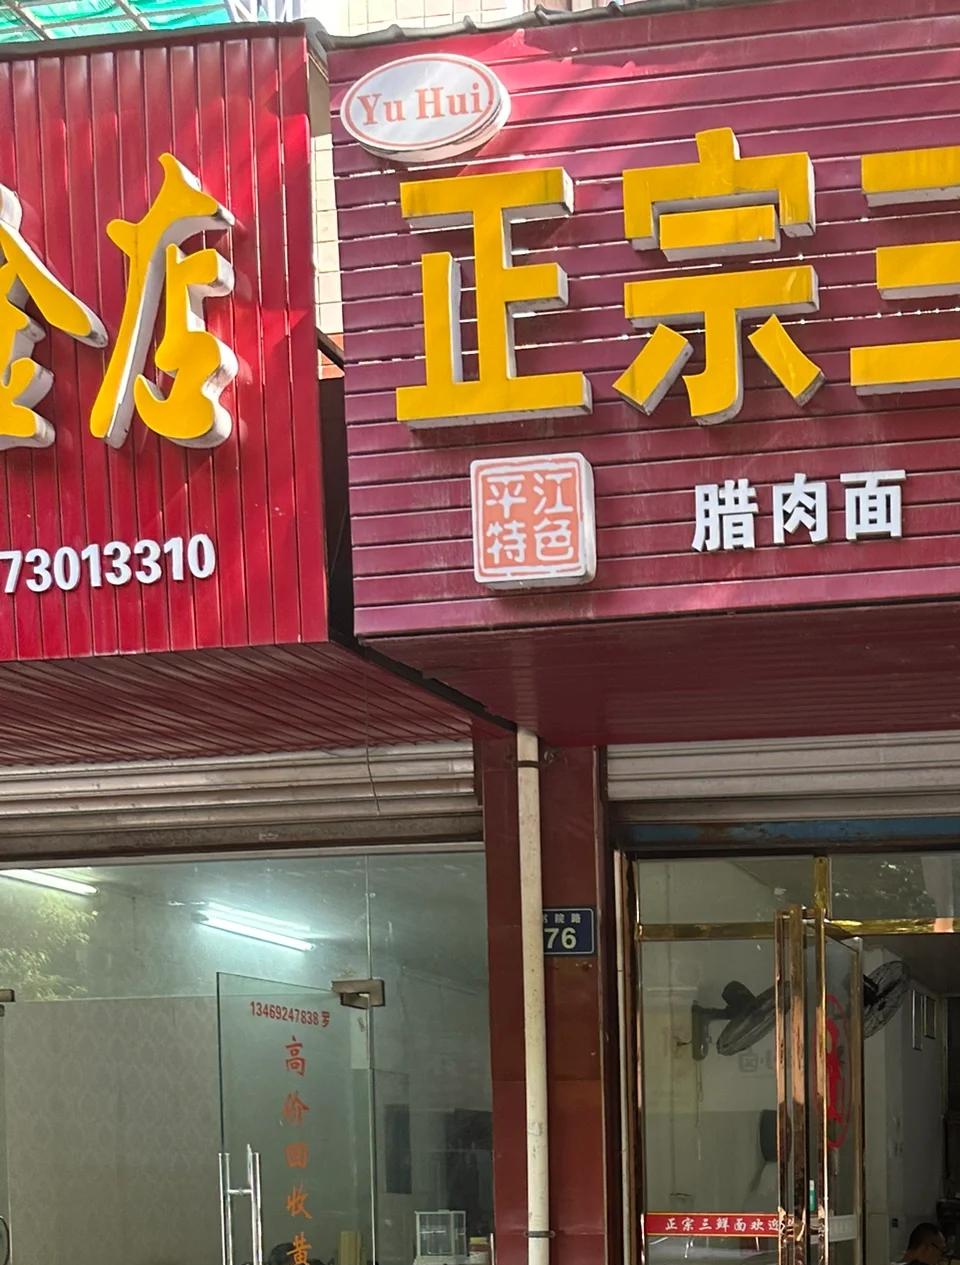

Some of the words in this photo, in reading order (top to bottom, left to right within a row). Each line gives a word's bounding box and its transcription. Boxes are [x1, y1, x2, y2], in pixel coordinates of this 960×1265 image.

[357, 93, 406, 126] Yu
[416, 83, 483, 120] Hui
[484, 472, 574, 517] 平江
[692, 469, 906, 551] 腊肉面
[0, 533, 216, 593] 73013310
[484, 520, 574, 565] 特色
[544, 927, 577, 949] 76
